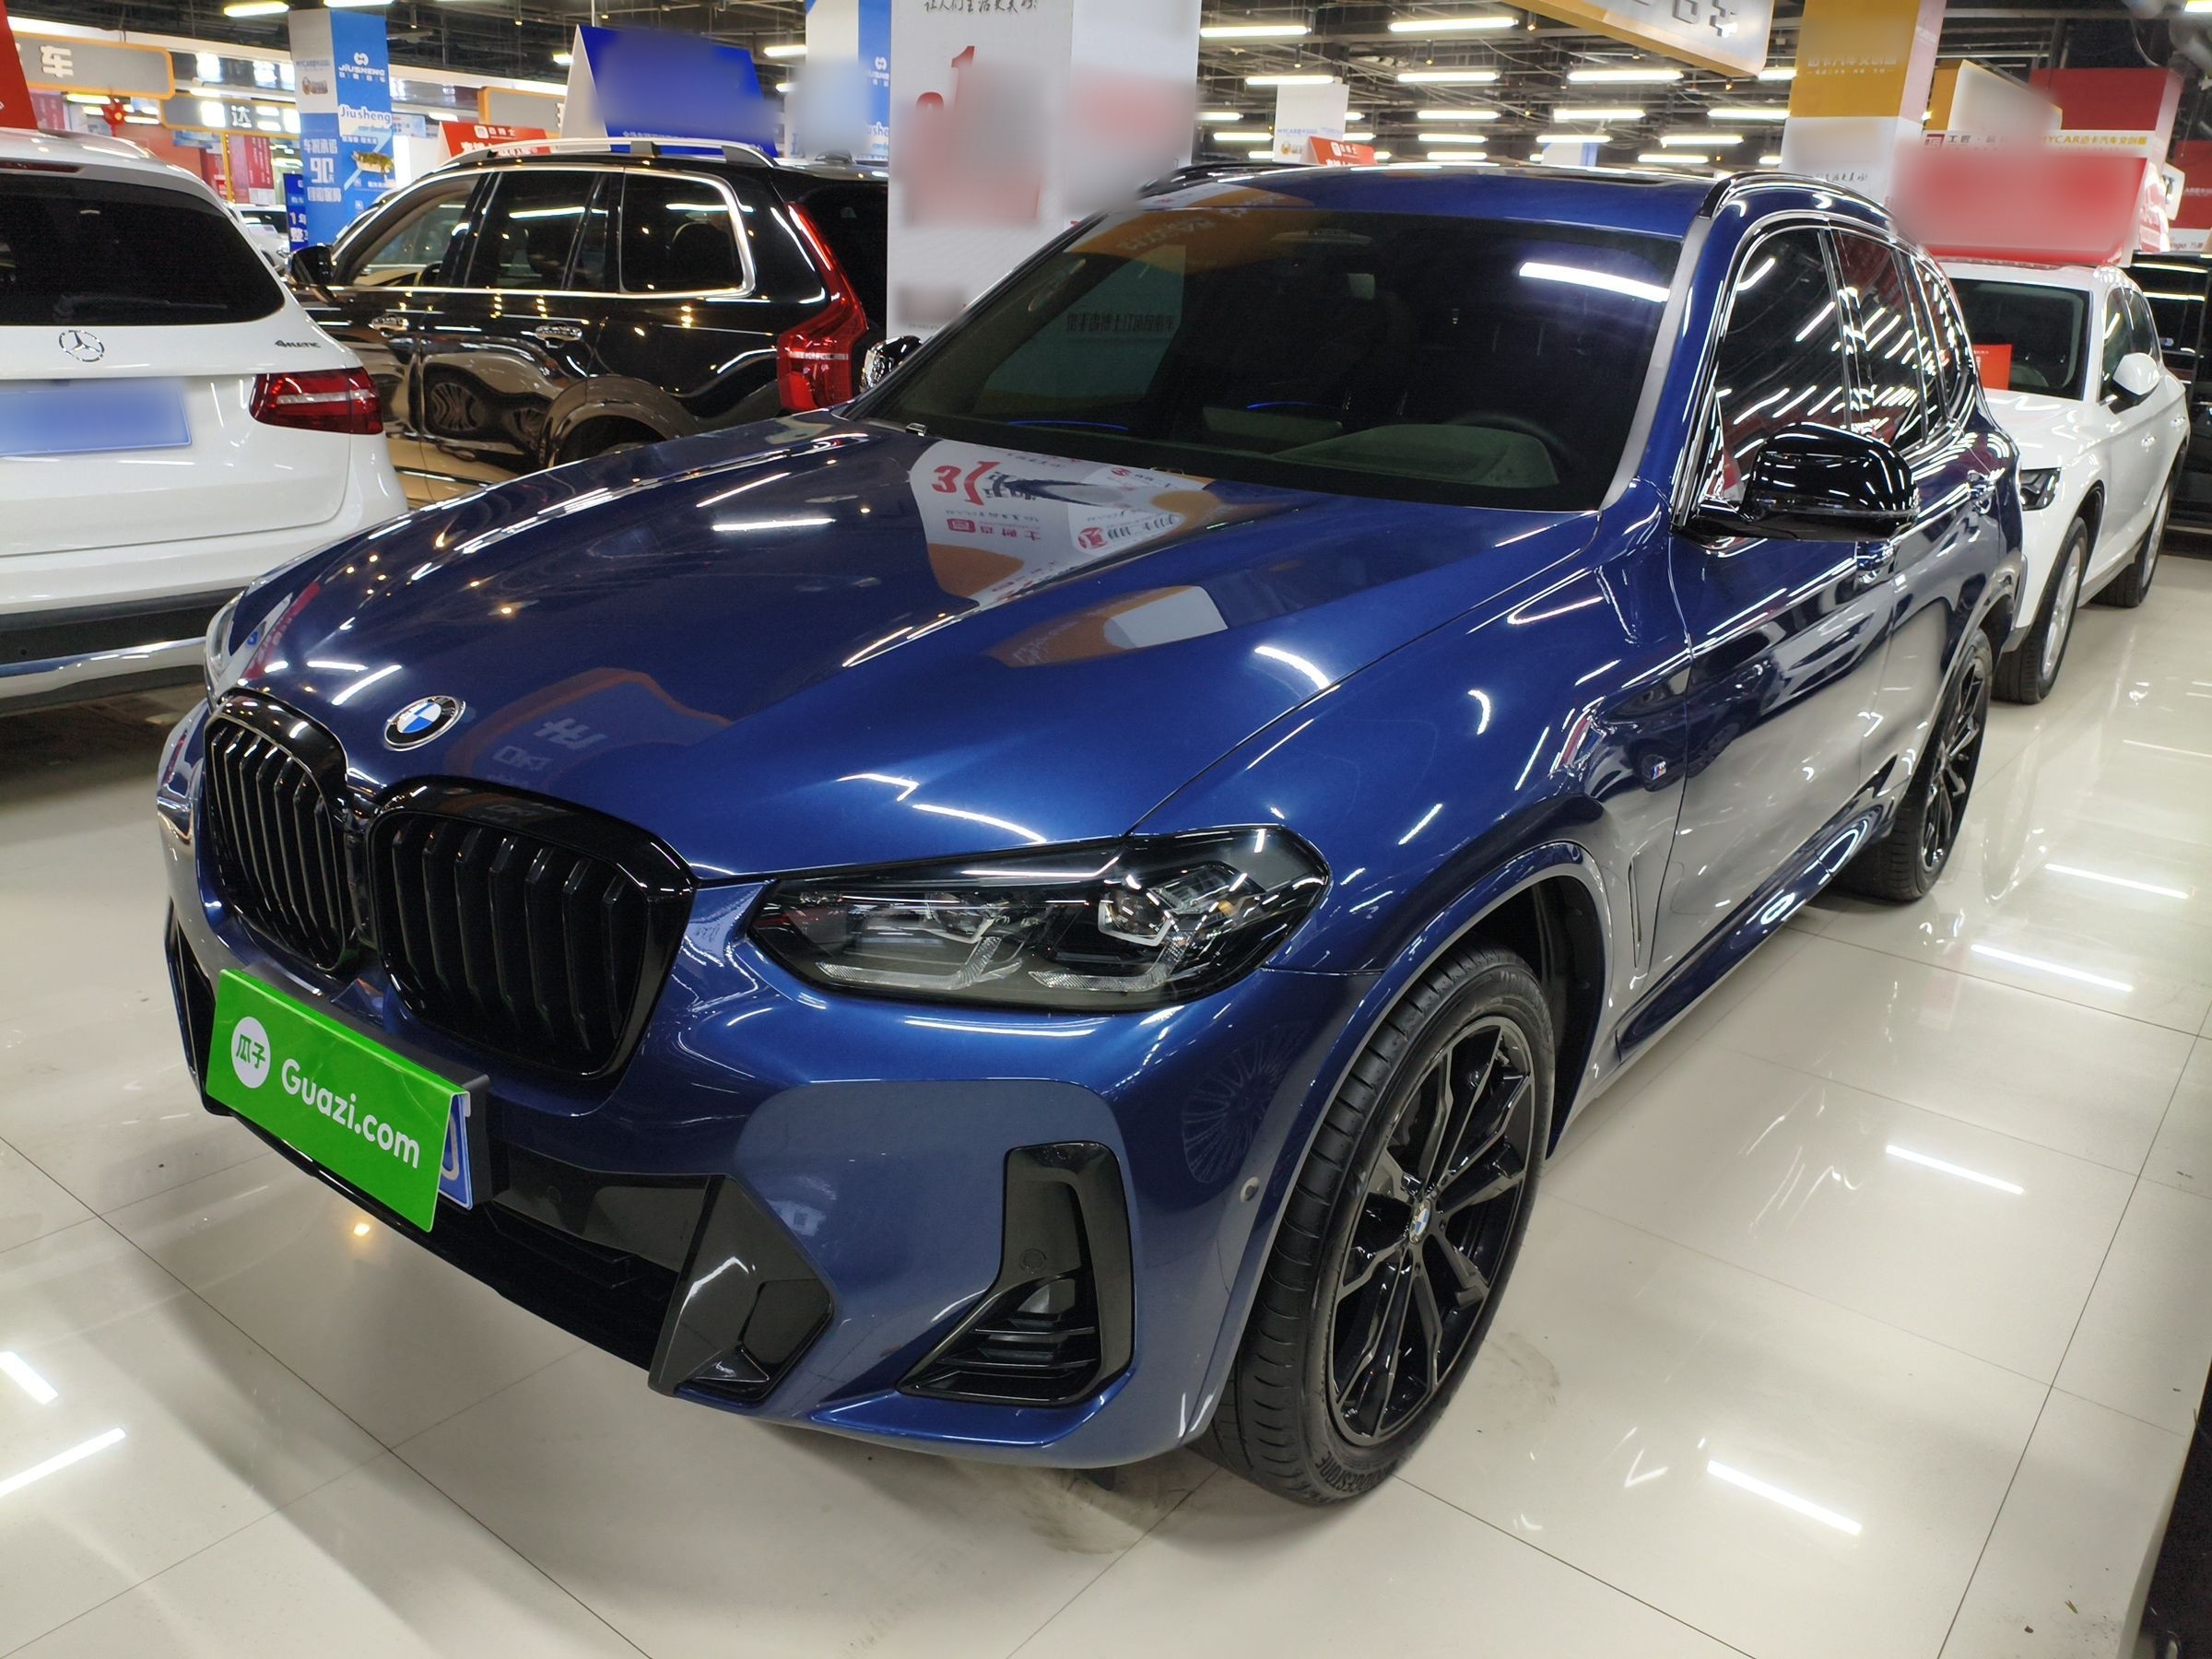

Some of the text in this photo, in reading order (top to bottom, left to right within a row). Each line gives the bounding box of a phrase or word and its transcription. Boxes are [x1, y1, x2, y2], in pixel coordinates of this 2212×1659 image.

[339, 105, 392, 124] Jiusheng
[235, 1033, 266, 1070] 瓜子
[281, 1058, 420, 1169] Guazi.com
